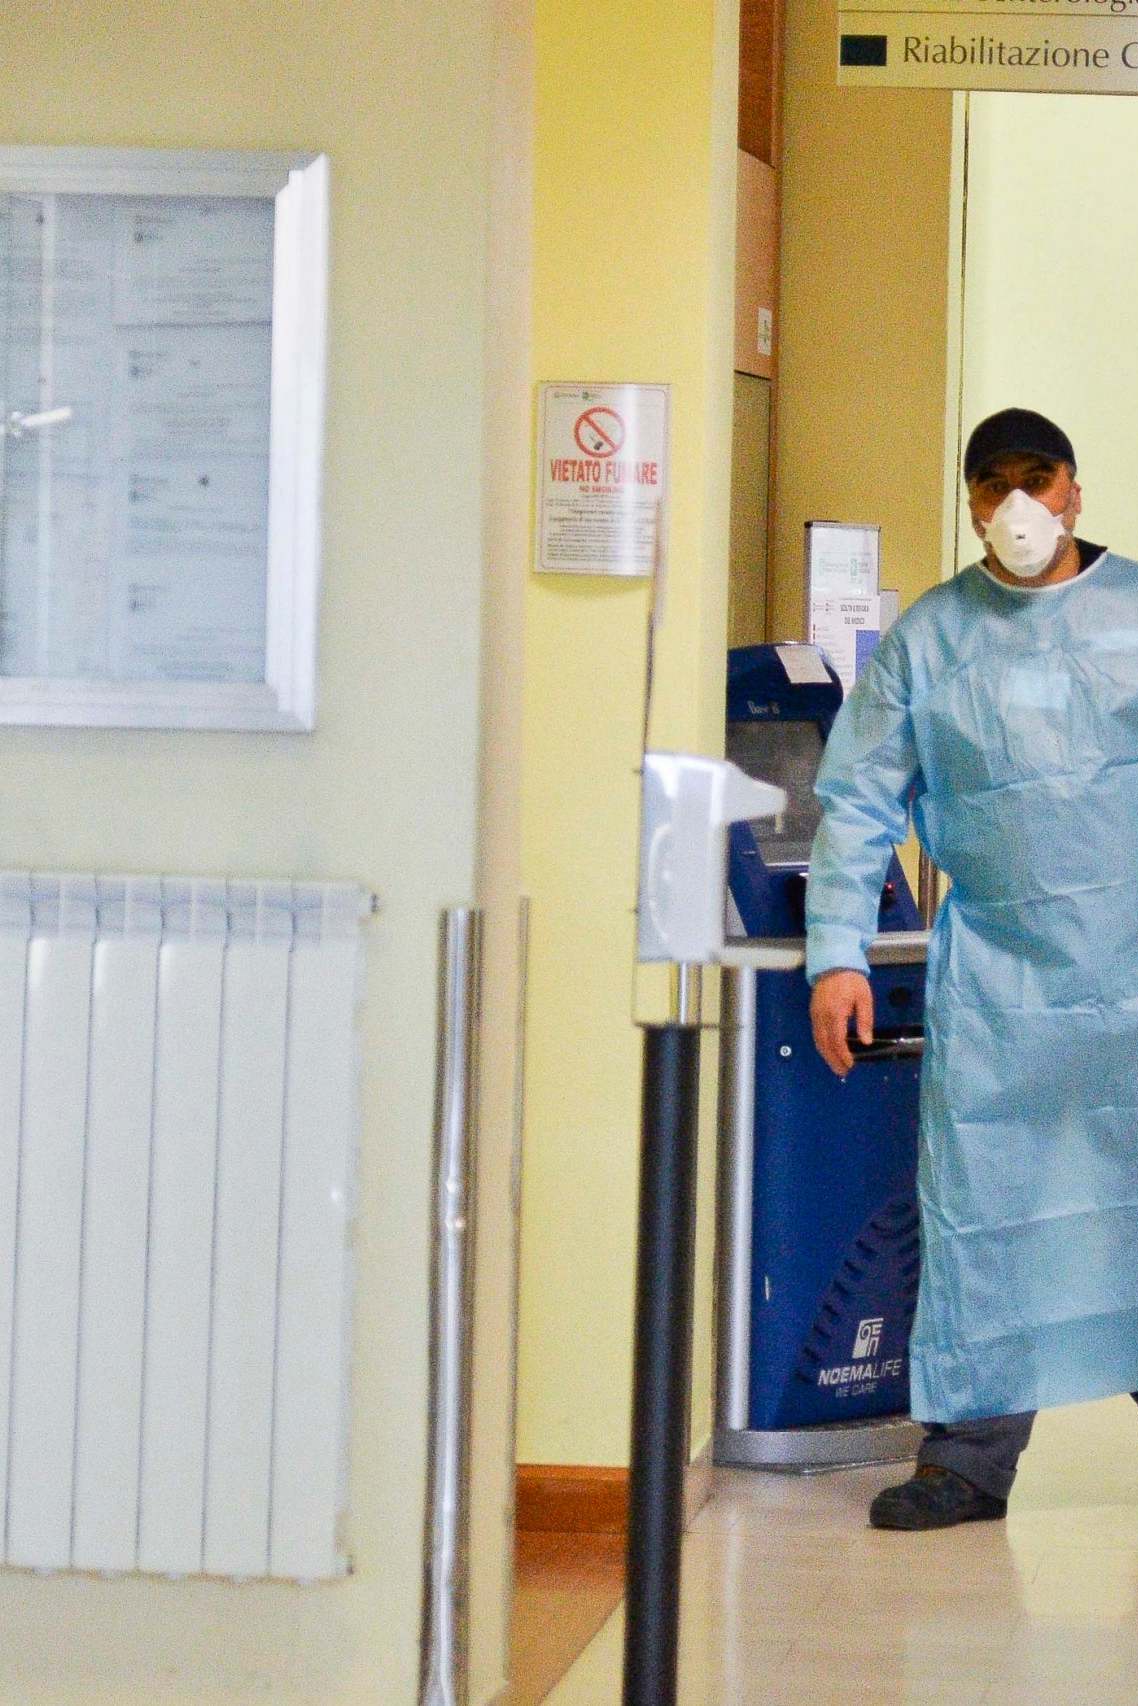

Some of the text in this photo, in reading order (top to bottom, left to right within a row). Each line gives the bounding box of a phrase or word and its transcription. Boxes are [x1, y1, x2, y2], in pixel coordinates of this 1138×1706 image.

[903, 36, 1110, 69] Riabilitazione
[551, 459, 657, 484] VIETATO FUARE
[818, 1359, 902, 1386] NOEMALIFE
